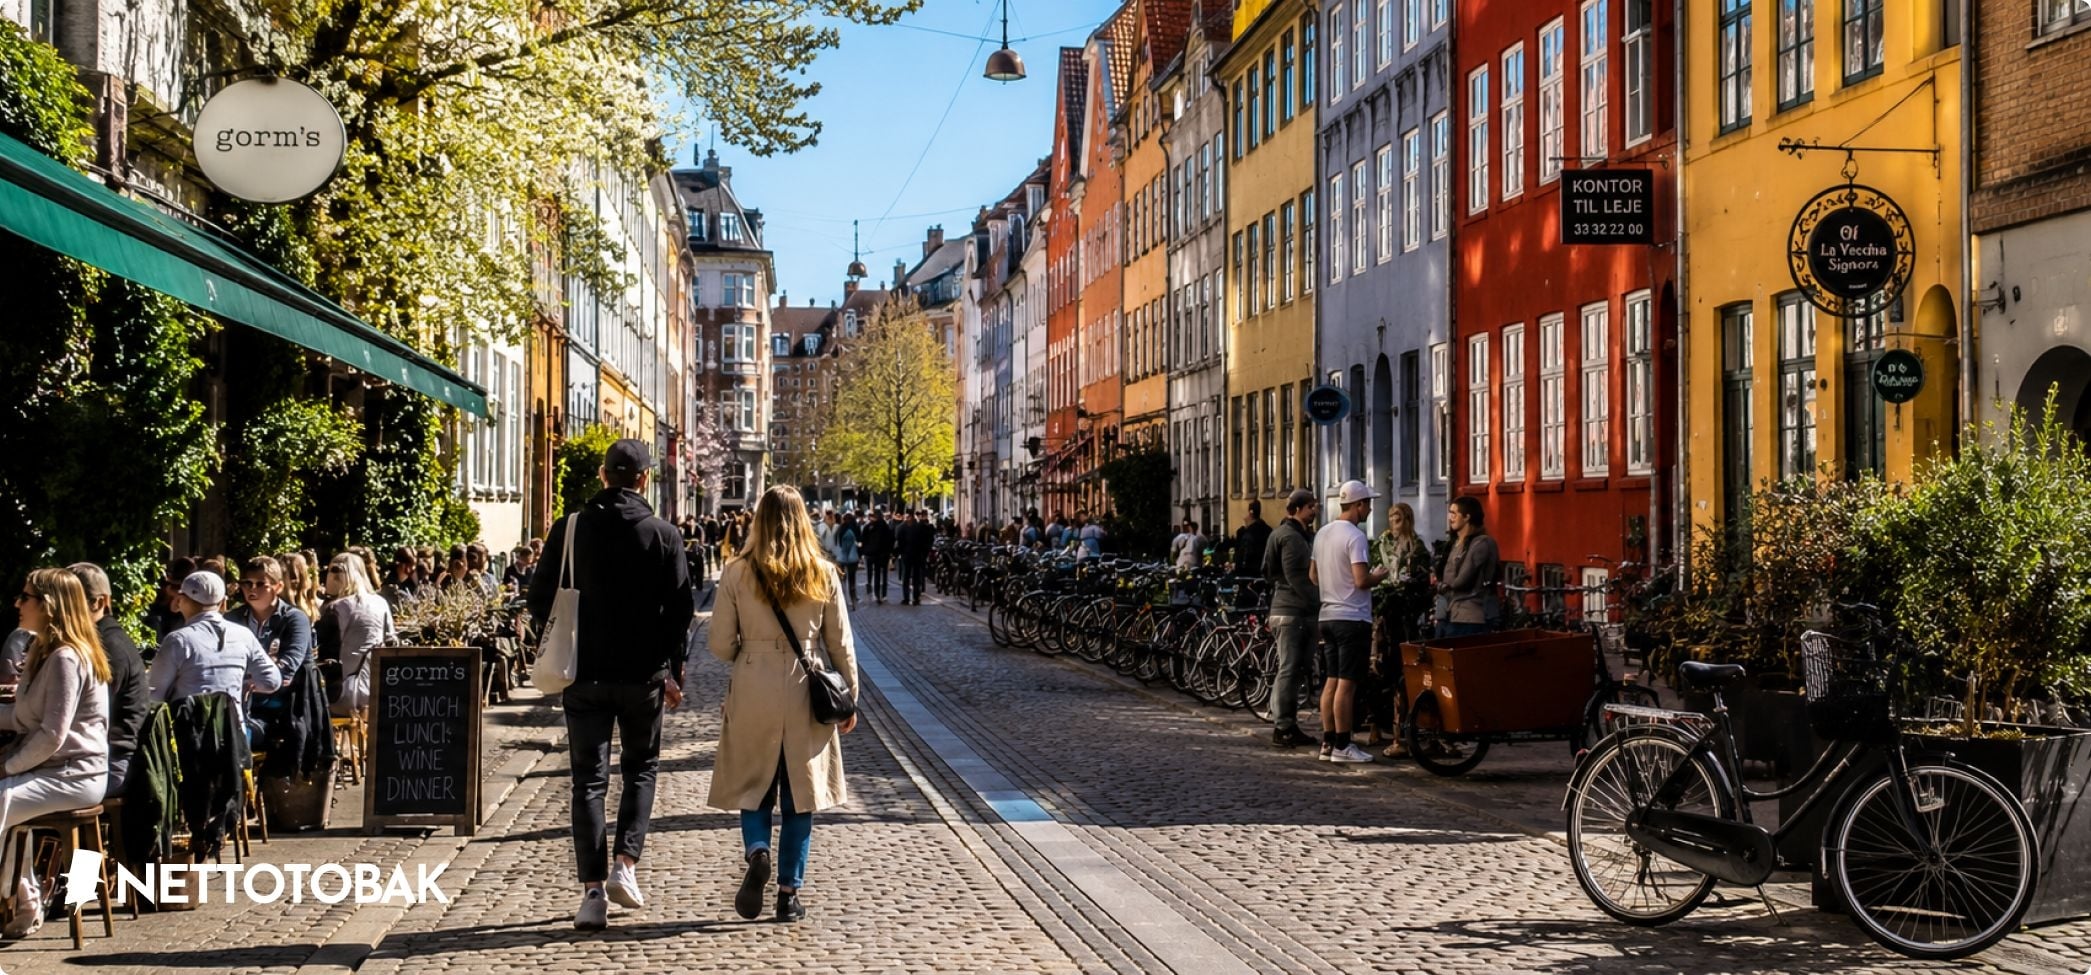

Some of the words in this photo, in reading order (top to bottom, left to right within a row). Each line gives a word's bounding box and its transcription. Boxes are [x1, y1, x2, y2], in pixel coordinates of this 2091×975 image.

[216, 126, 320, 152] gorm's
[1572, 179, 1643, 193] KONTOR
[1573, 199, 1598, 214] TIL
[1603, 199, 1643, 214] LEJE
[1574, 223, 1589, 236] 33
[1591, 223, 1607, 236] 32
[1609, 223, 1625, 236] 22
[1628, 223, 1644, 236] 00
[385, 661, 466, 686] gorm's
[388, 695, 459, 719] BRUNCH
[397, 746, 444, 771] WINE
[386, 775, 456, 801] DINNER
